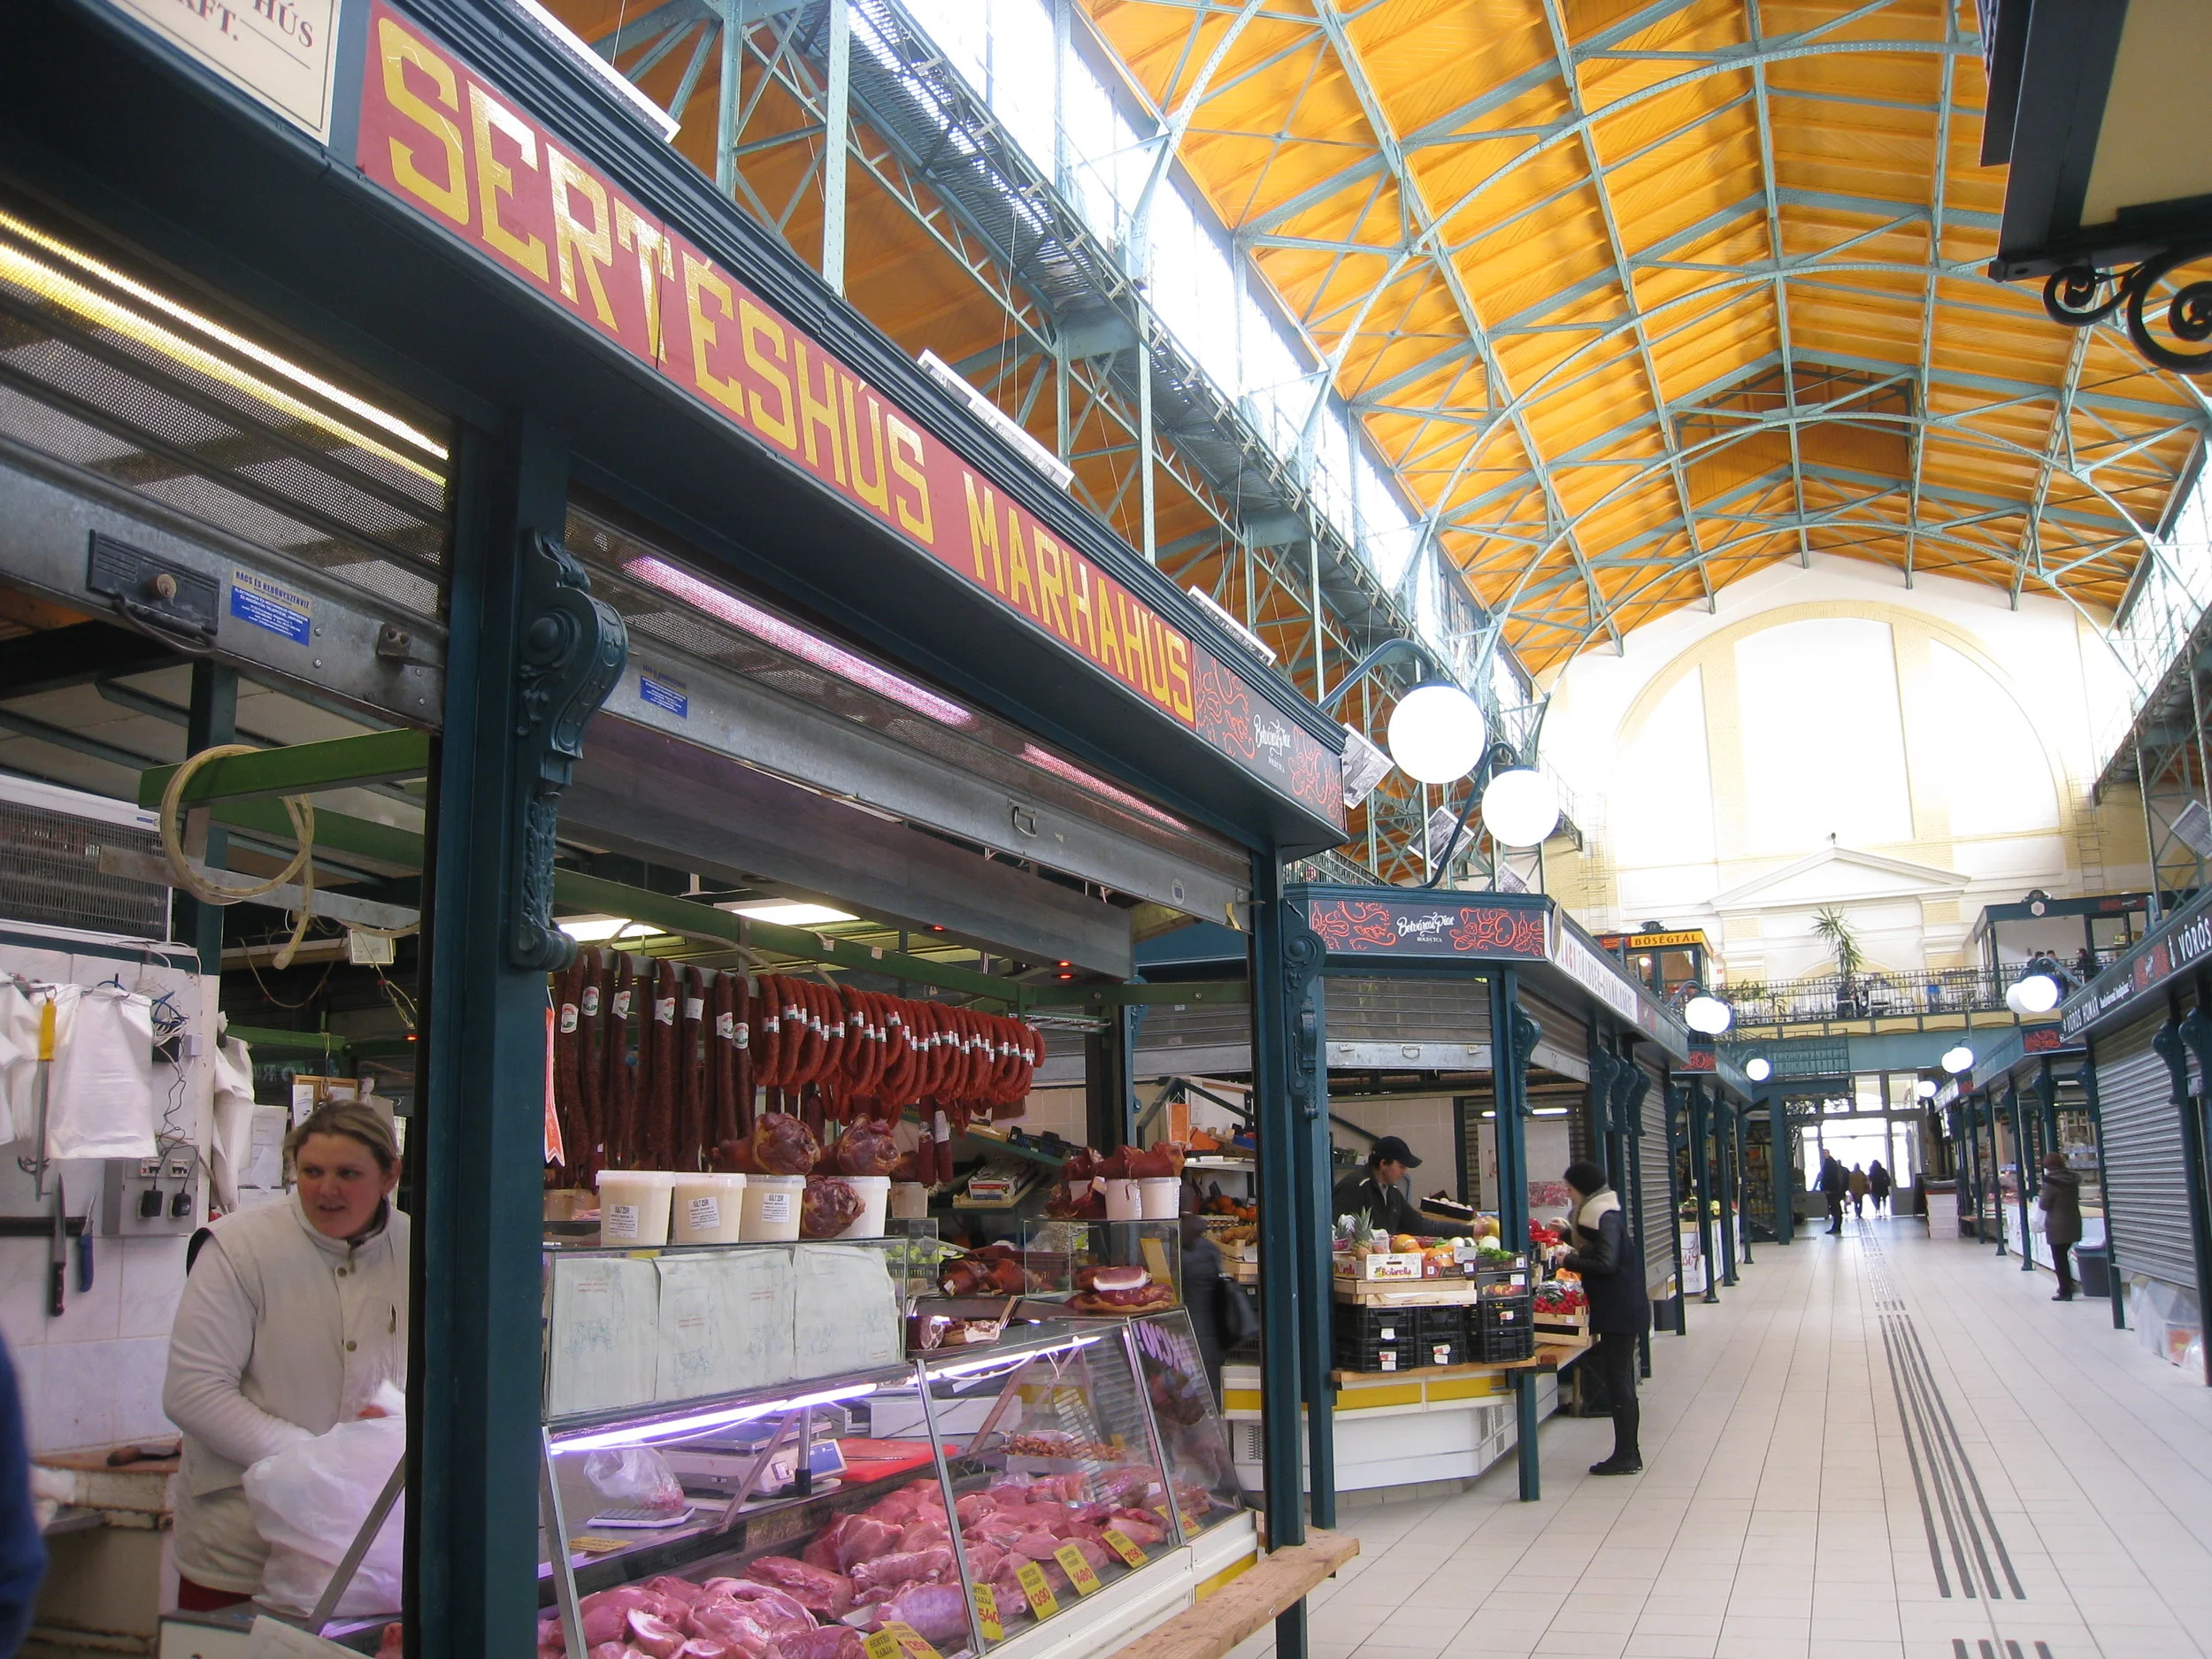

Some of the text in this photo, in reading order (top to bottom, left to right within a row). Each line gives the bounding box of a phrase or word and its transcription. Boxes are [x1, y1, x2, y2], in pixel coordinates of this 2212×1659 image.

[378, 17, 1194, 723] SERTÉSHÚS MARHAHÚS
[1634, 933, 1699, 946] BŐSÉGTÁL
[1030, 1587, 1051, 1608] 1390
[869, 1632, 891, 1648] SERTÉS
